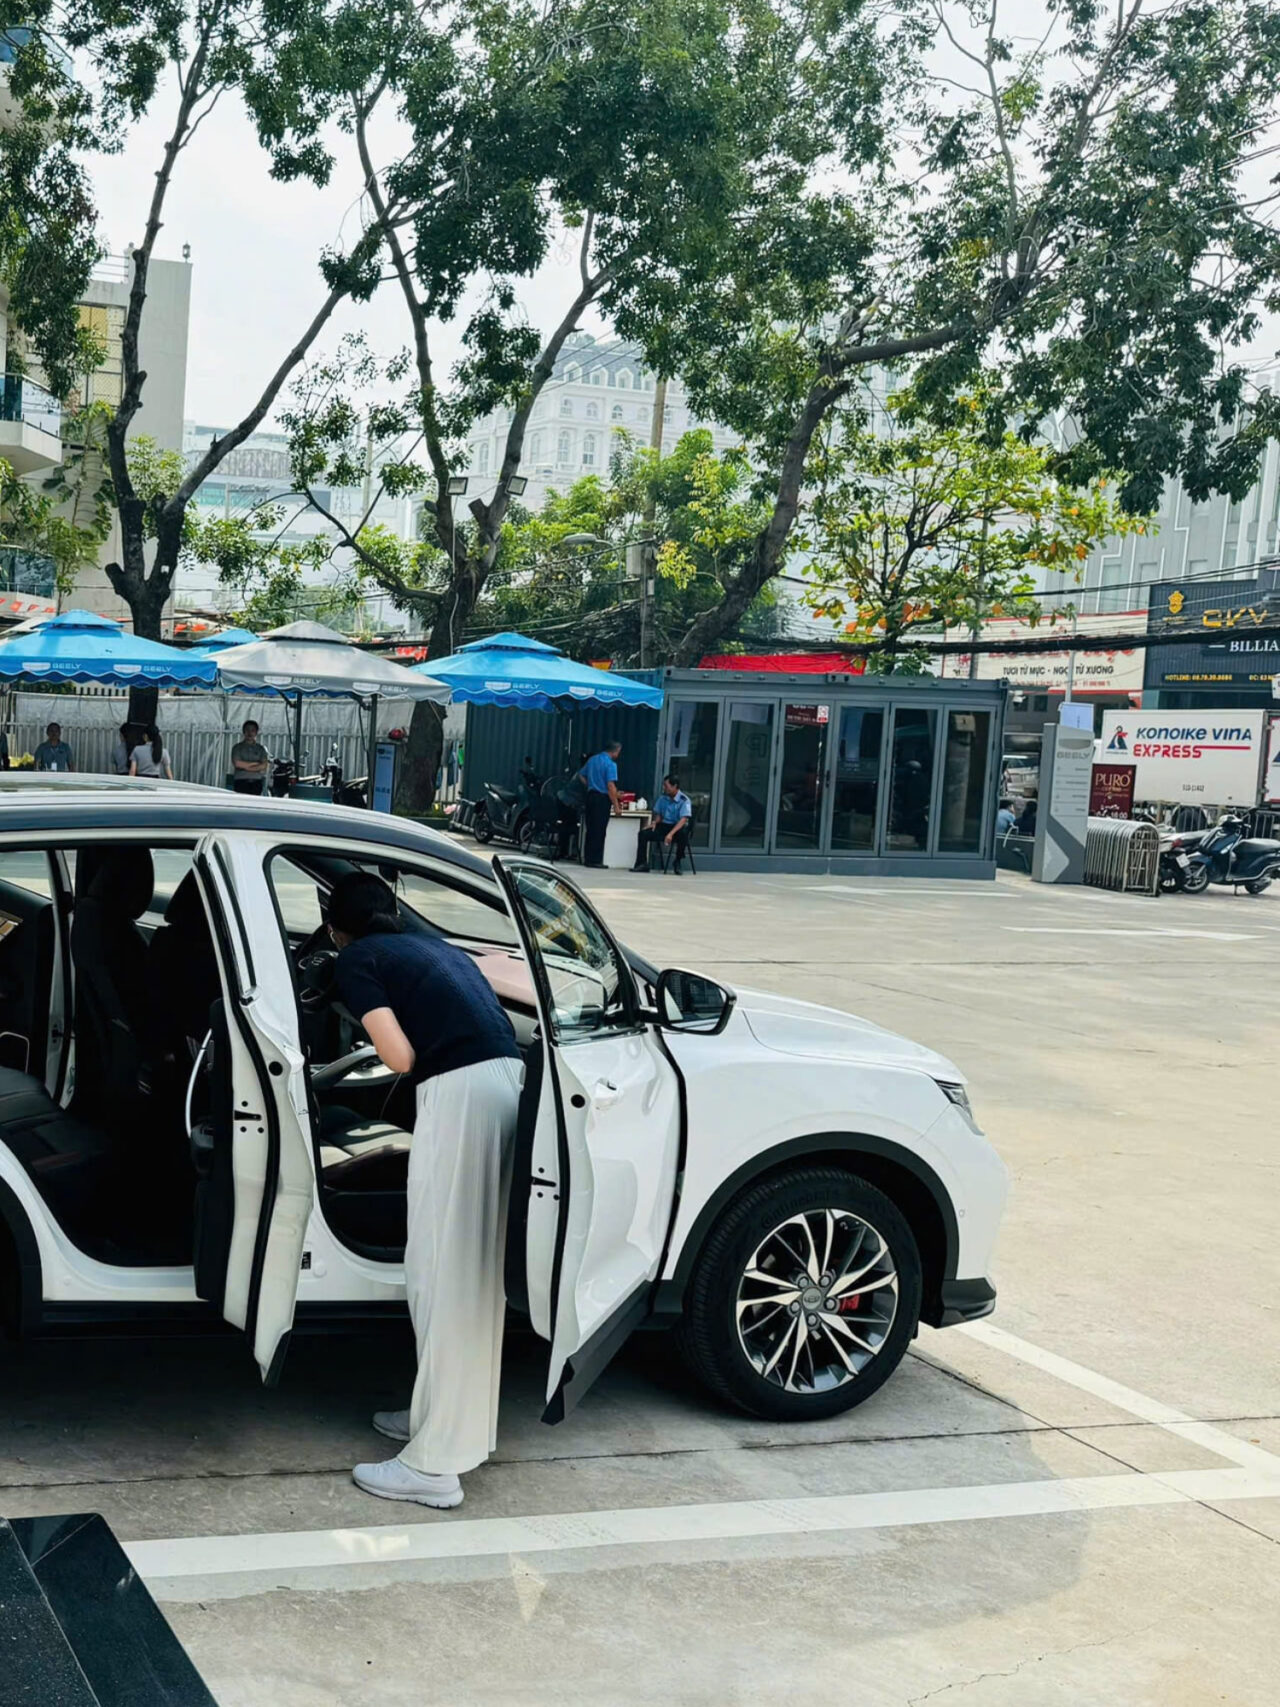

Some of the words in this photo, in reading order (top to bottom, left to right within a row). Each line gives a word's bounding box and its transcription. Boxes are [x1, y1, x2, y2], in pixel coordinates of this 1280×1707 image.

[1230, 641, 1280, 652] BILLIA
[1133, 743, 1202, 758] EXPRESS
[1095, 773, 1131, 787] PURO
